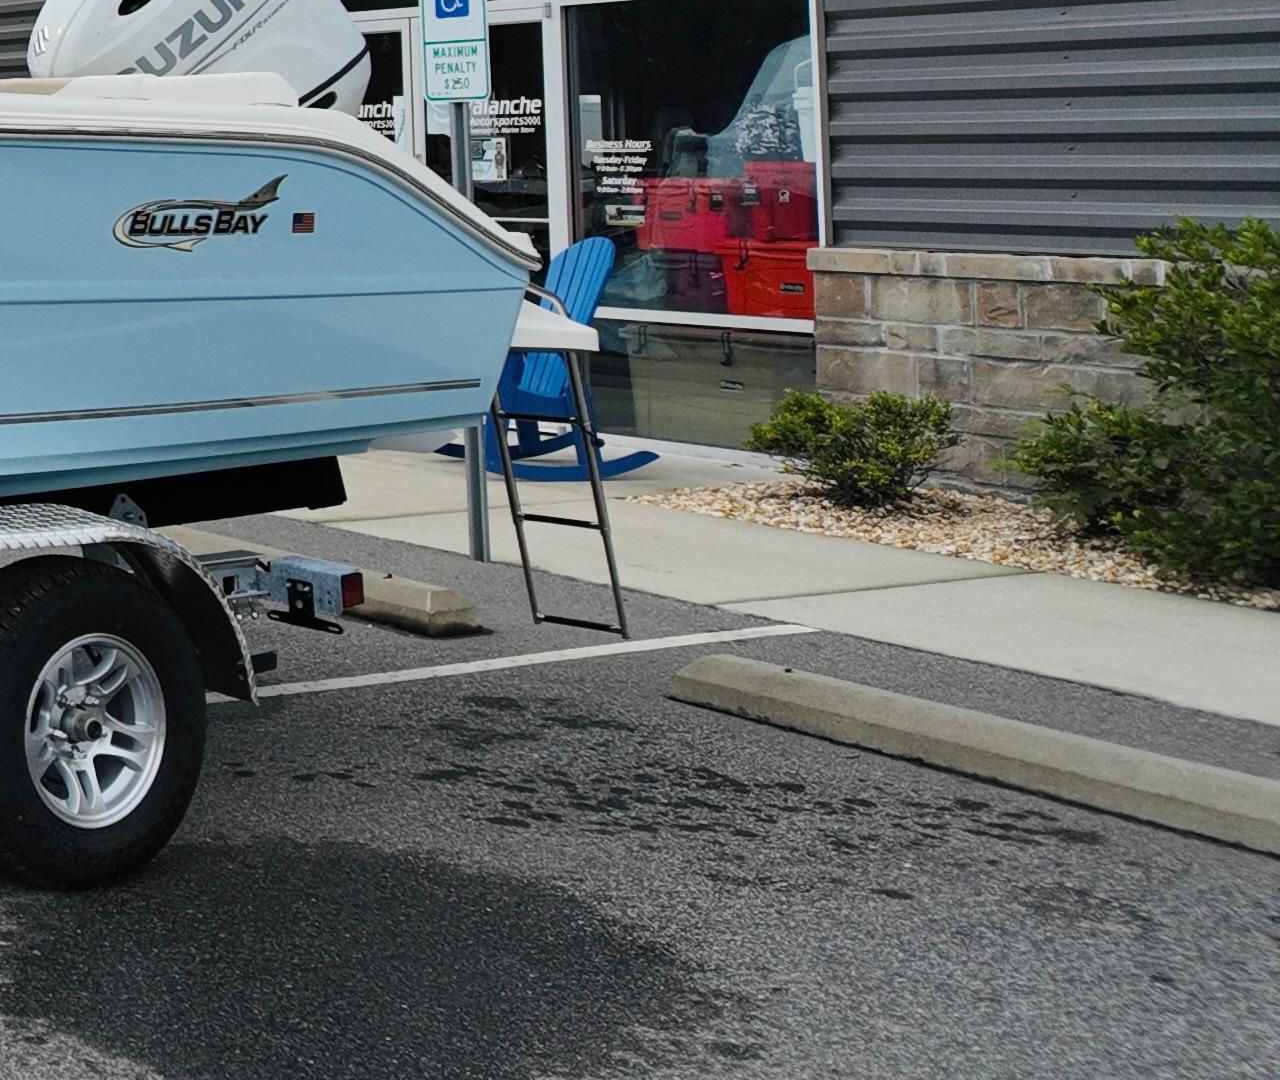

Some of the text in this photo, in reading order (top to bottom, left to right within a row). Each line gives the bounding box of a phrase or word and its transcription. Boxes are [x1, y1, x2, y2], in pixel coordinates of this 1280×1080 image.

[432, 45, 478, 58] MAXIMUM
[434, 60, 477, 75] PENALTY
[470, 96, 542, 115] alanche
[624, 139, 652, 150] Hours
